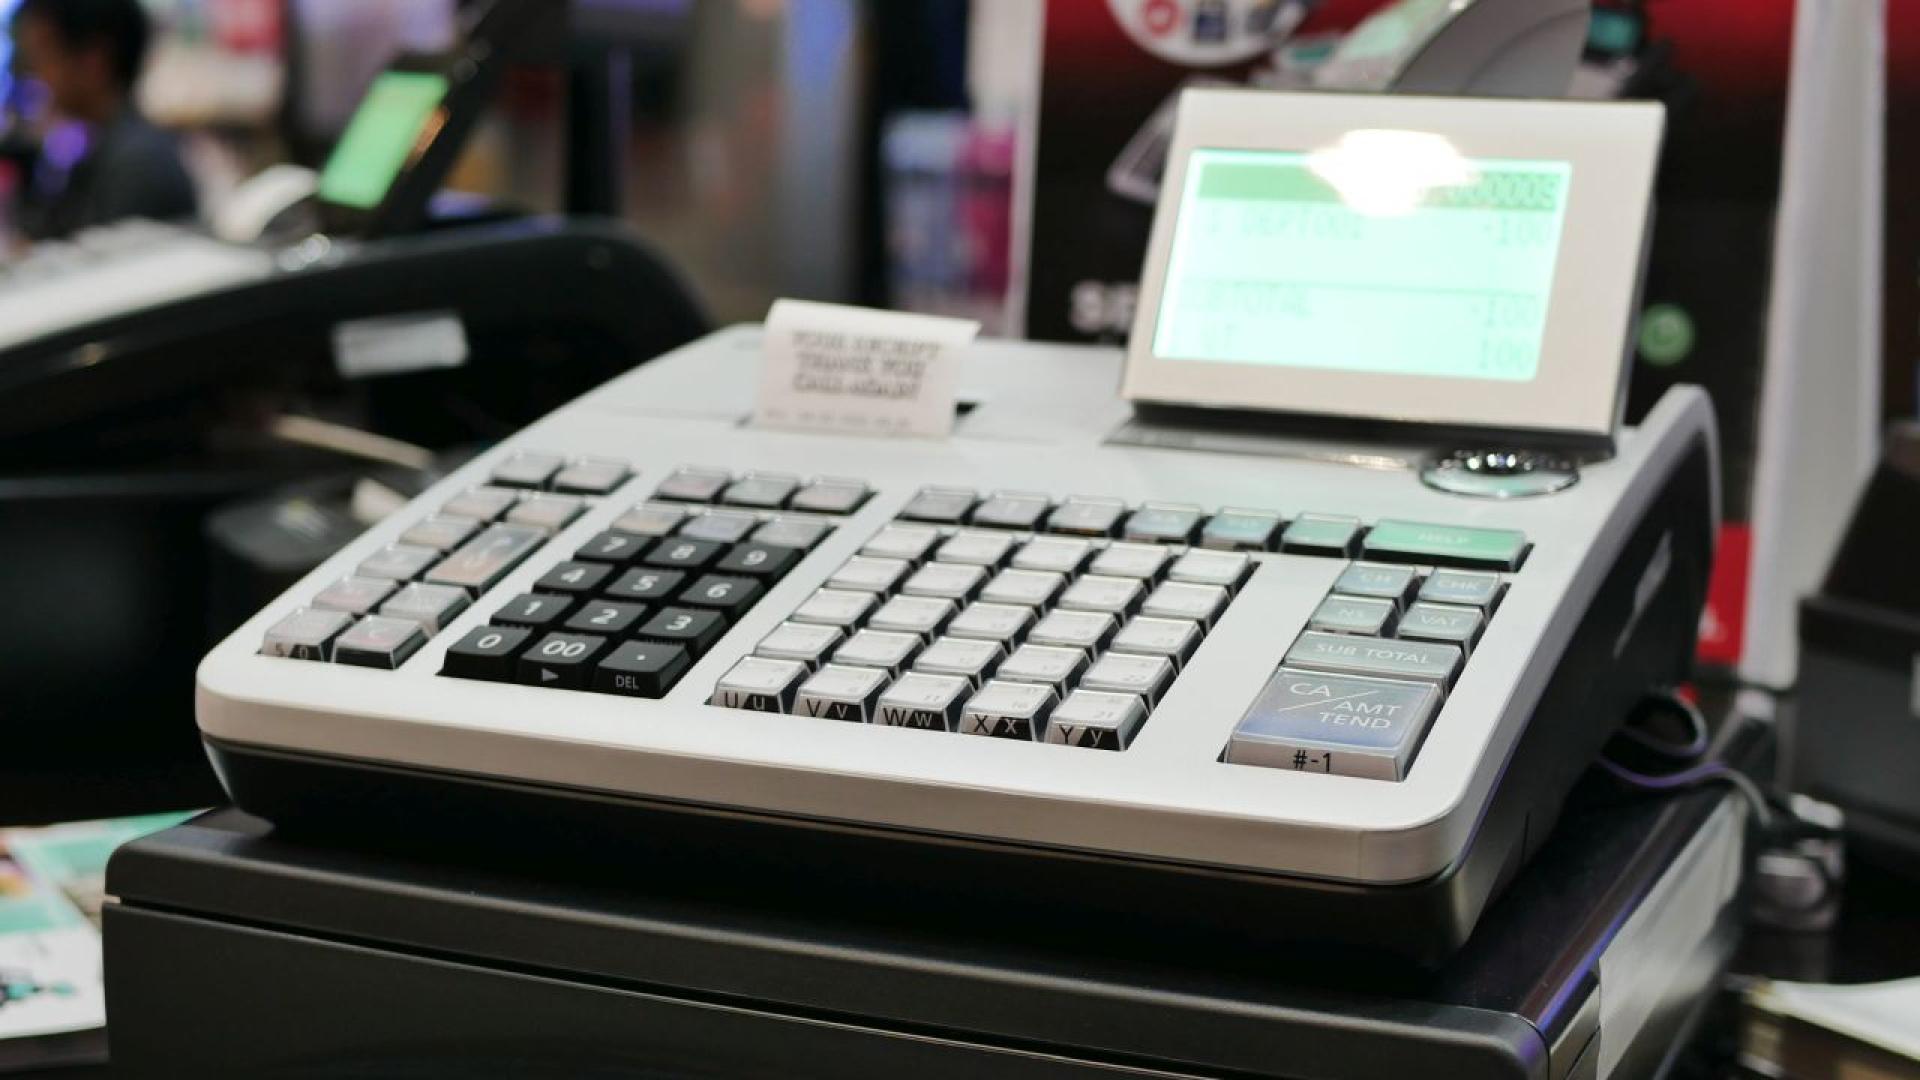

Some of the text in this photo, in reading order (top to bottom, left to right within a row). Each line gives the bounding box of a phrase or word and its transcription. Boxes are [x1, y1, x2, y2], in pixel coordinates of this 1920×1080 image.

[602, 536, 627, 552] 7
[671, 545, 696, 560] 8
[743, 550, 767, 566] 9
[561, 568, 586, 583] 4
[632, 575, 659, 592] 5
[707, 583, 732, 598] 6
[1437, 577, 1482, 591] CHK
[524, 600, 543, 616] 1
[590, 608, 619, 624] 2
[666, 615, 692, 631] 3
[1420, 614, 1460, 626] VAT
[477, 634, 502, 649] 0
[542, 640, 586, 657] 00
[1316, 642, 1431, 664] SUB TOTAL
[616, 674, 640, 690] DEL
[1289, 682, 1333, 697] CA
[725, 692, 739, 709] U
[1332, 700, 1402, 715] AMT
[806, 701, 821, 718] V
[883, 707, 907, 726] W
[973, 713, 989, 733] X
[1319, 712, 1394, 729] TEND
[1058, 725, 1075, 745] Y
[1293, 750, 1333, 773] #-1
